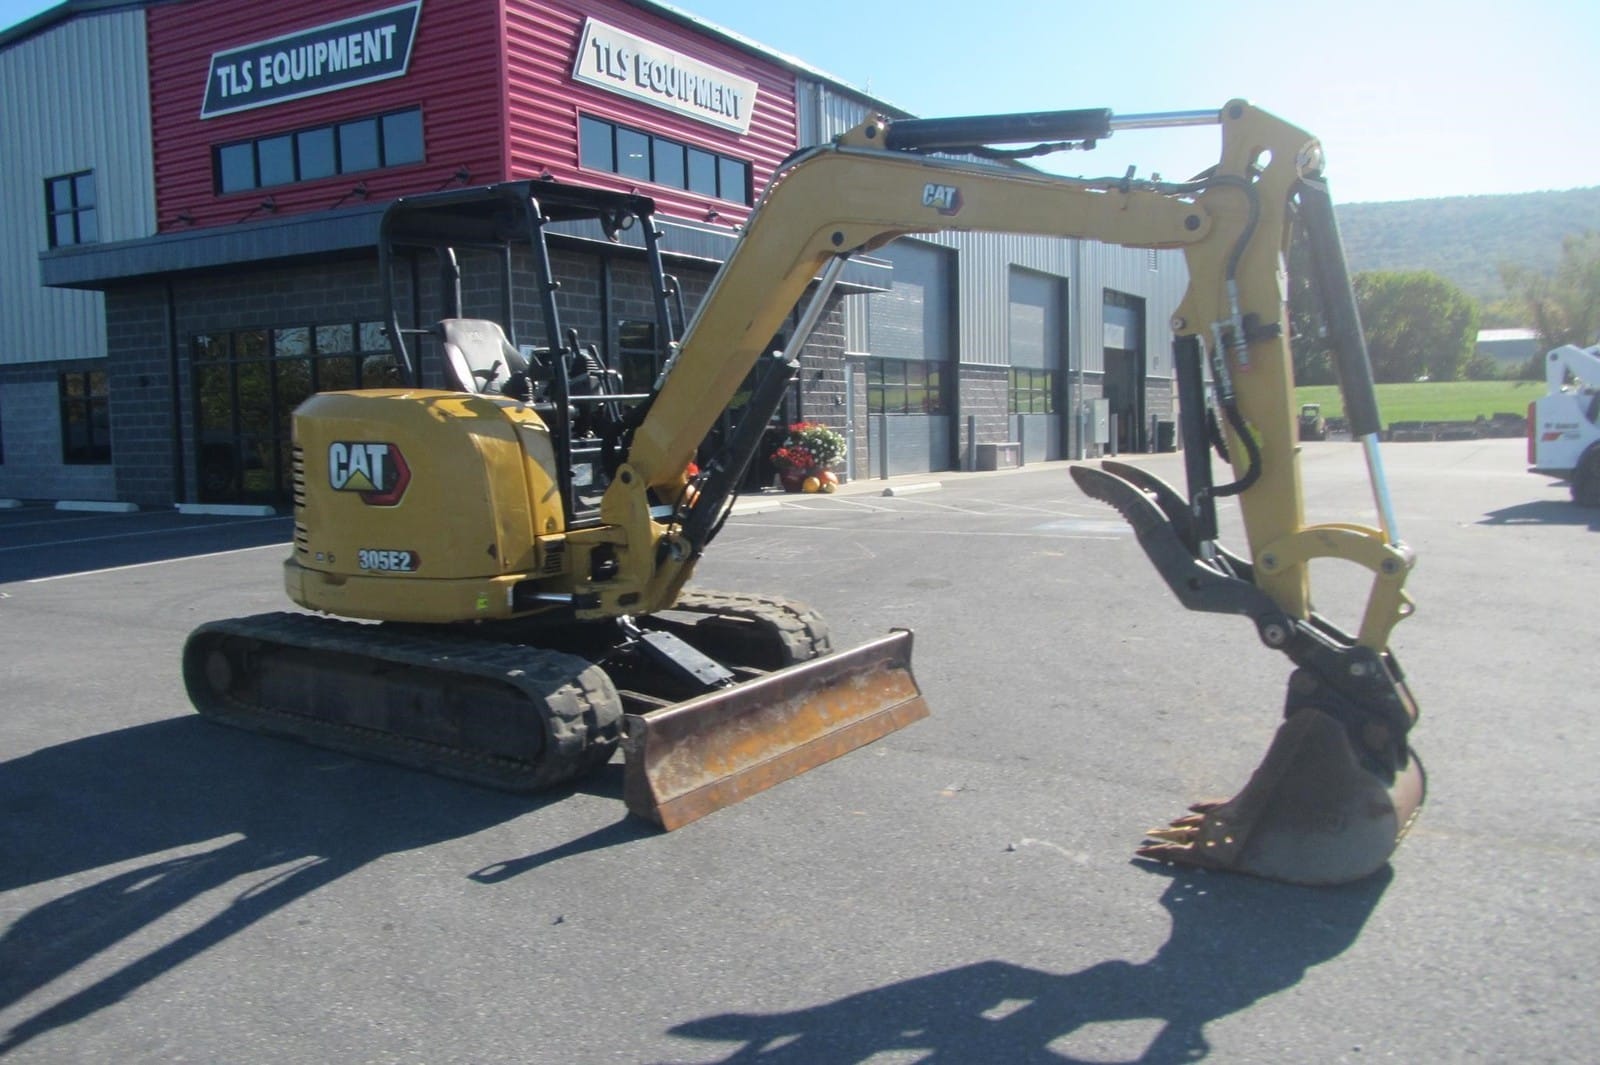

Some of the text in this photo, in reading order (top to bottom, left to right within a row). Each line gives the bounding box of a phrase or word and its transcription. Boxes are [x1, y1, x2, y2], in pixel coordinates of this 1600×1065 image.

[217, 24, 397, 98] TLS EQUIPMENT
[592, 37, 743, 120] TLS EQUIPMENT
[922, 183, 956, 209] CAT
[329, 441, 388, 491] CAT
[358, 550, 411, 571] 305E2
